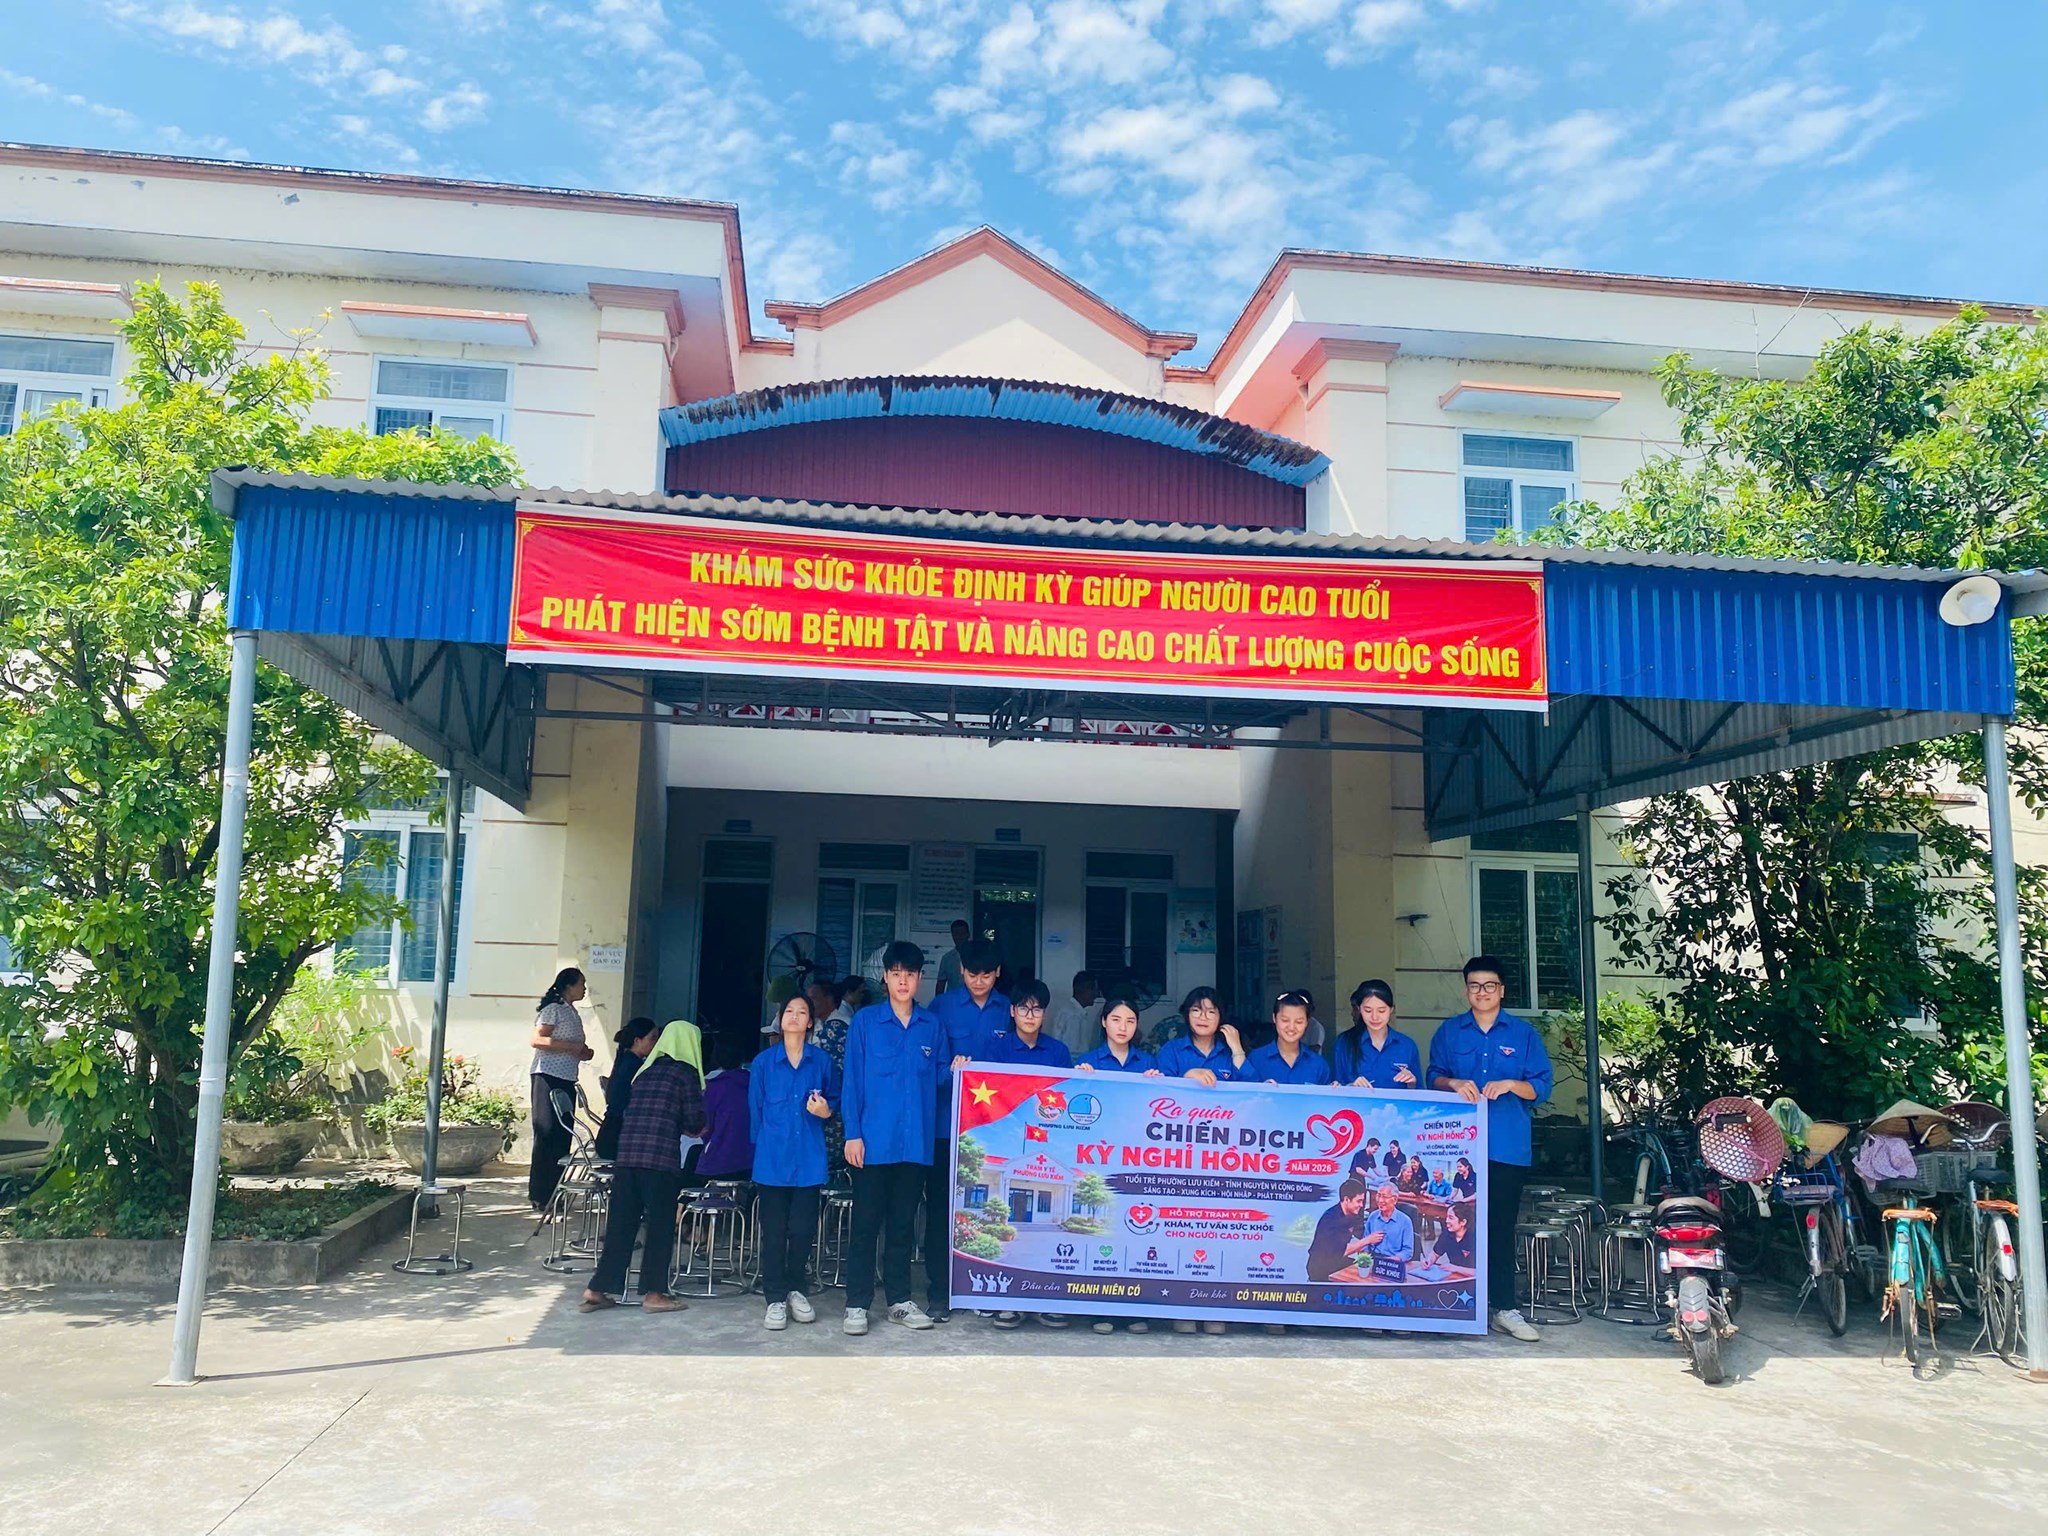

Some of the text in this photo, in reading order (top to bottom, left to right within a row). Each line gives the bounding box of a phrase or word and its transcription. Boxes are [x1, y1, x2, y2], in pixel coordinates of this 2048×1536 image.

[690, 549, 1390, 620] KHÁM SỨC KHỎE ĐỊNH KỲ GIÚP NGƯỜI CAO TUỔI
[541, 594, 1519, 679] PHÁT HIỆN SỚM BỆNH TẬT VÀ NÂNG CAO CHẤT LƯỢNG CUỘC SỐNG
[1148, 1097, 1235, 1124] Ra quân
[1424, 1120, 1461, 1130] CHIẾN DỊCH
[1146, 1120, 1304, 1153] CHIẾN DỊCH
[1076, 1140, 1280, 1174] KỲ NGHỈ HỒNG
[1292, 1163, 1332, 1173] NĂM 2026
[1158, 1177, 1186, 1186] PHƯỜNG
[1278, 1183, 1295, 1192] CỘNG
[1201, 1188, 1216, 1196] KÍCH
[1204, 1211, 1229, 1219] TRẠM
[1164, 1220, 1194, 1229] KHÁM,
[1210, 1222, 1228, 1230] VẤN
[1066, 1283, 1099, 1294] THANH
[1102, 1284, 1124, 1295] NIÊN
[1127, 1285, 1141, 1296] CÓ
[1236, 1288, 1249, 1300] CÓ
[1252, 1291, 1282, 1302] THANH
[1285, 1291, 1308, 1302] NIÊN
